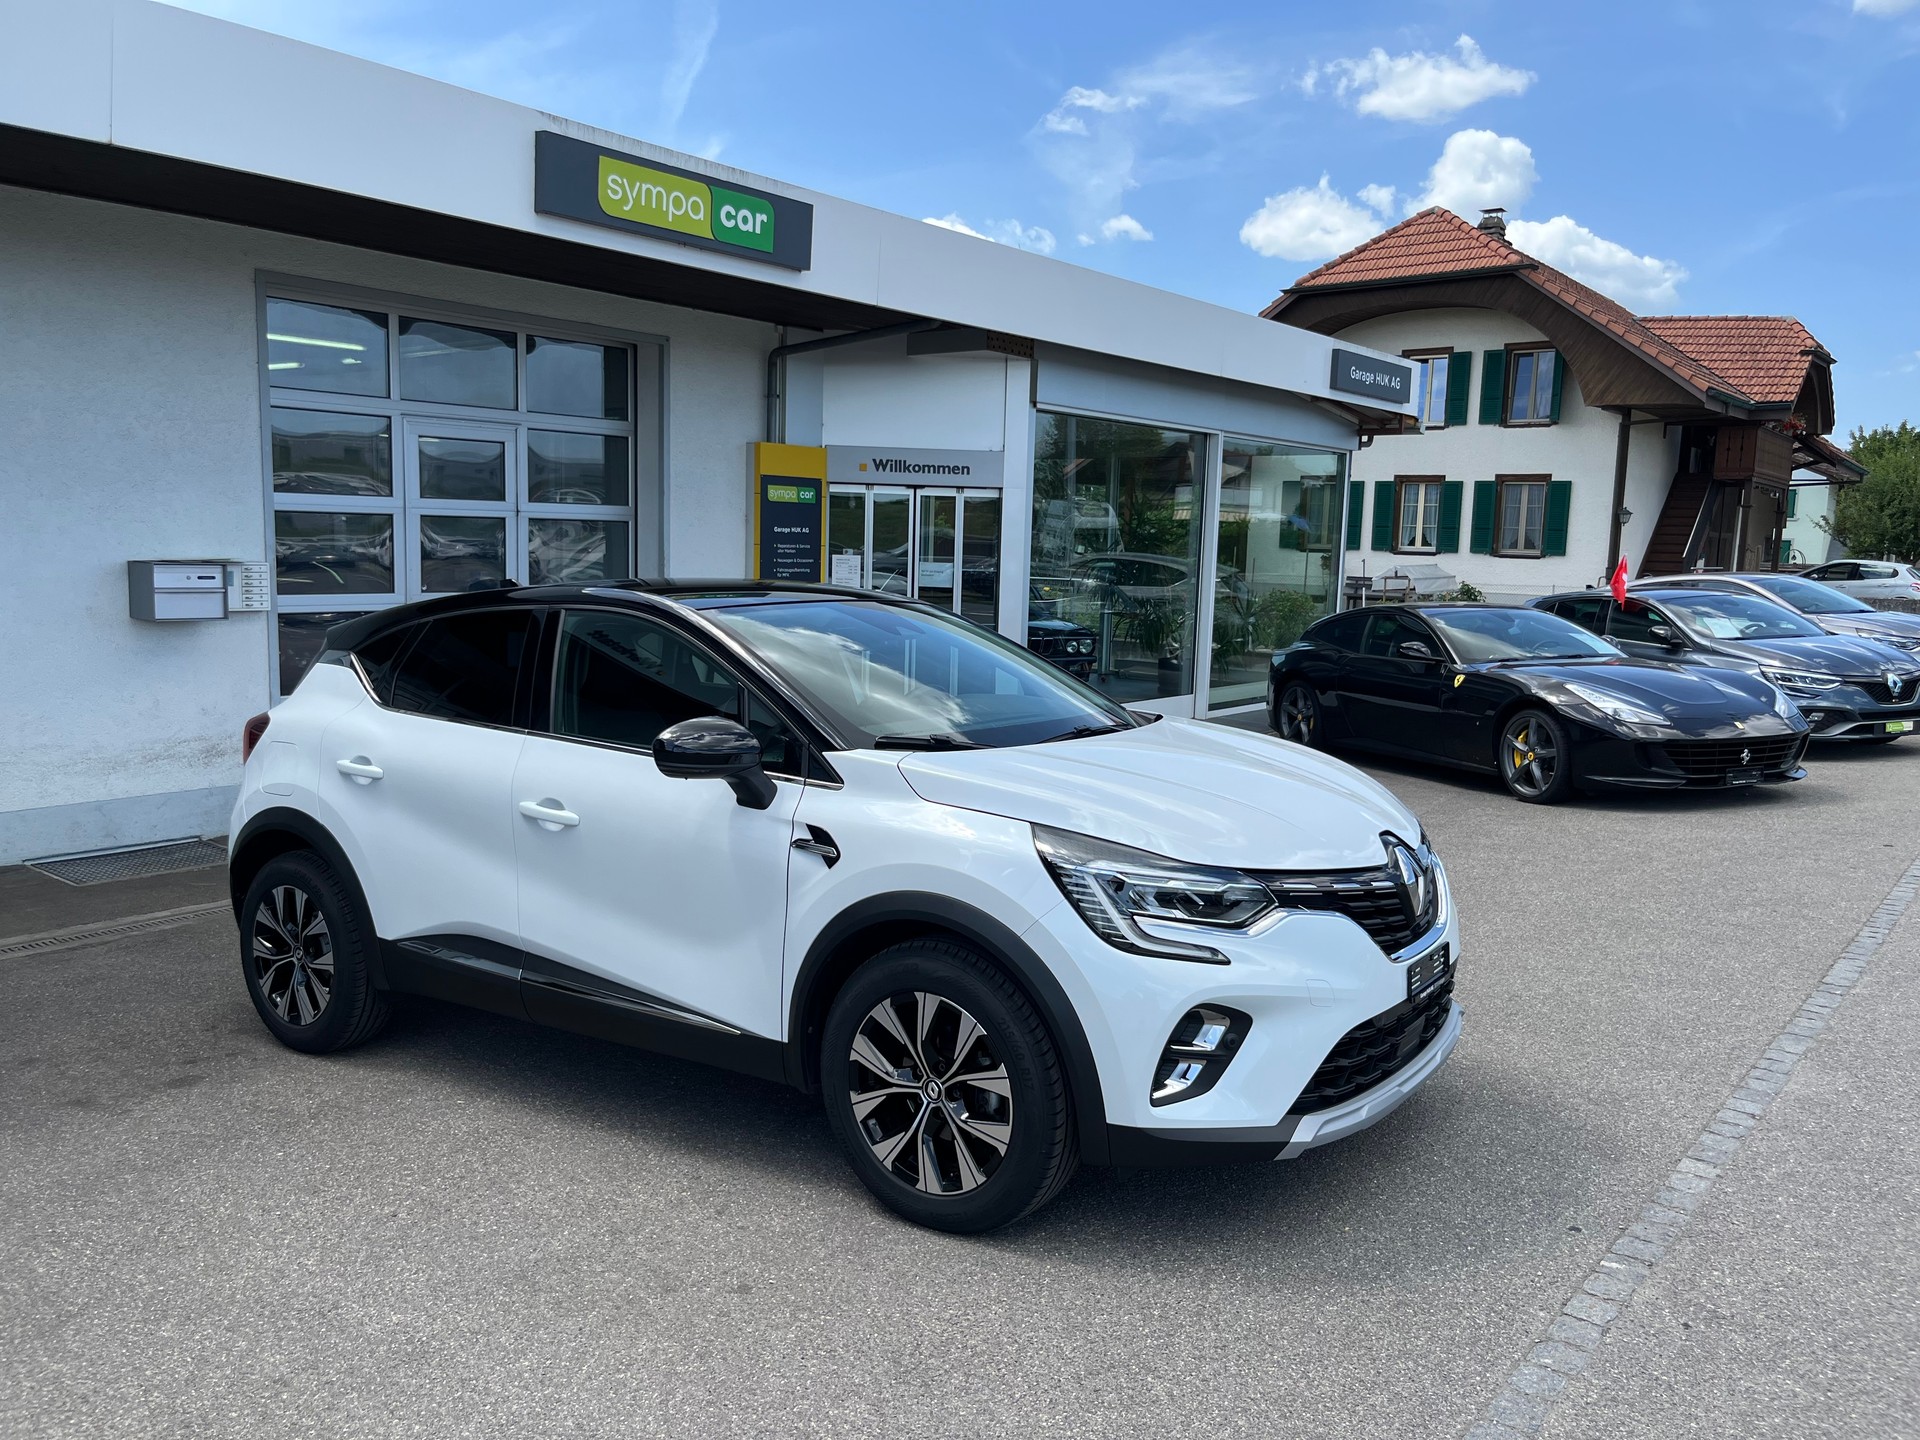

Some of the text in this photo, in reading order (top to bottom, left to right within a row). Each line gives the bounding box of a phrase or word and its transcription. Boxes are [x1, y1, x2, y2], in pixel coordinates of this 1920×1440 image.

[607, 174, 768, 235] sympa car
[1350, 366, 1401, 389] Garage HUK AG
[872, 458, 971, 476] Willkommen
[769, 489, 814, 500] sympa car
